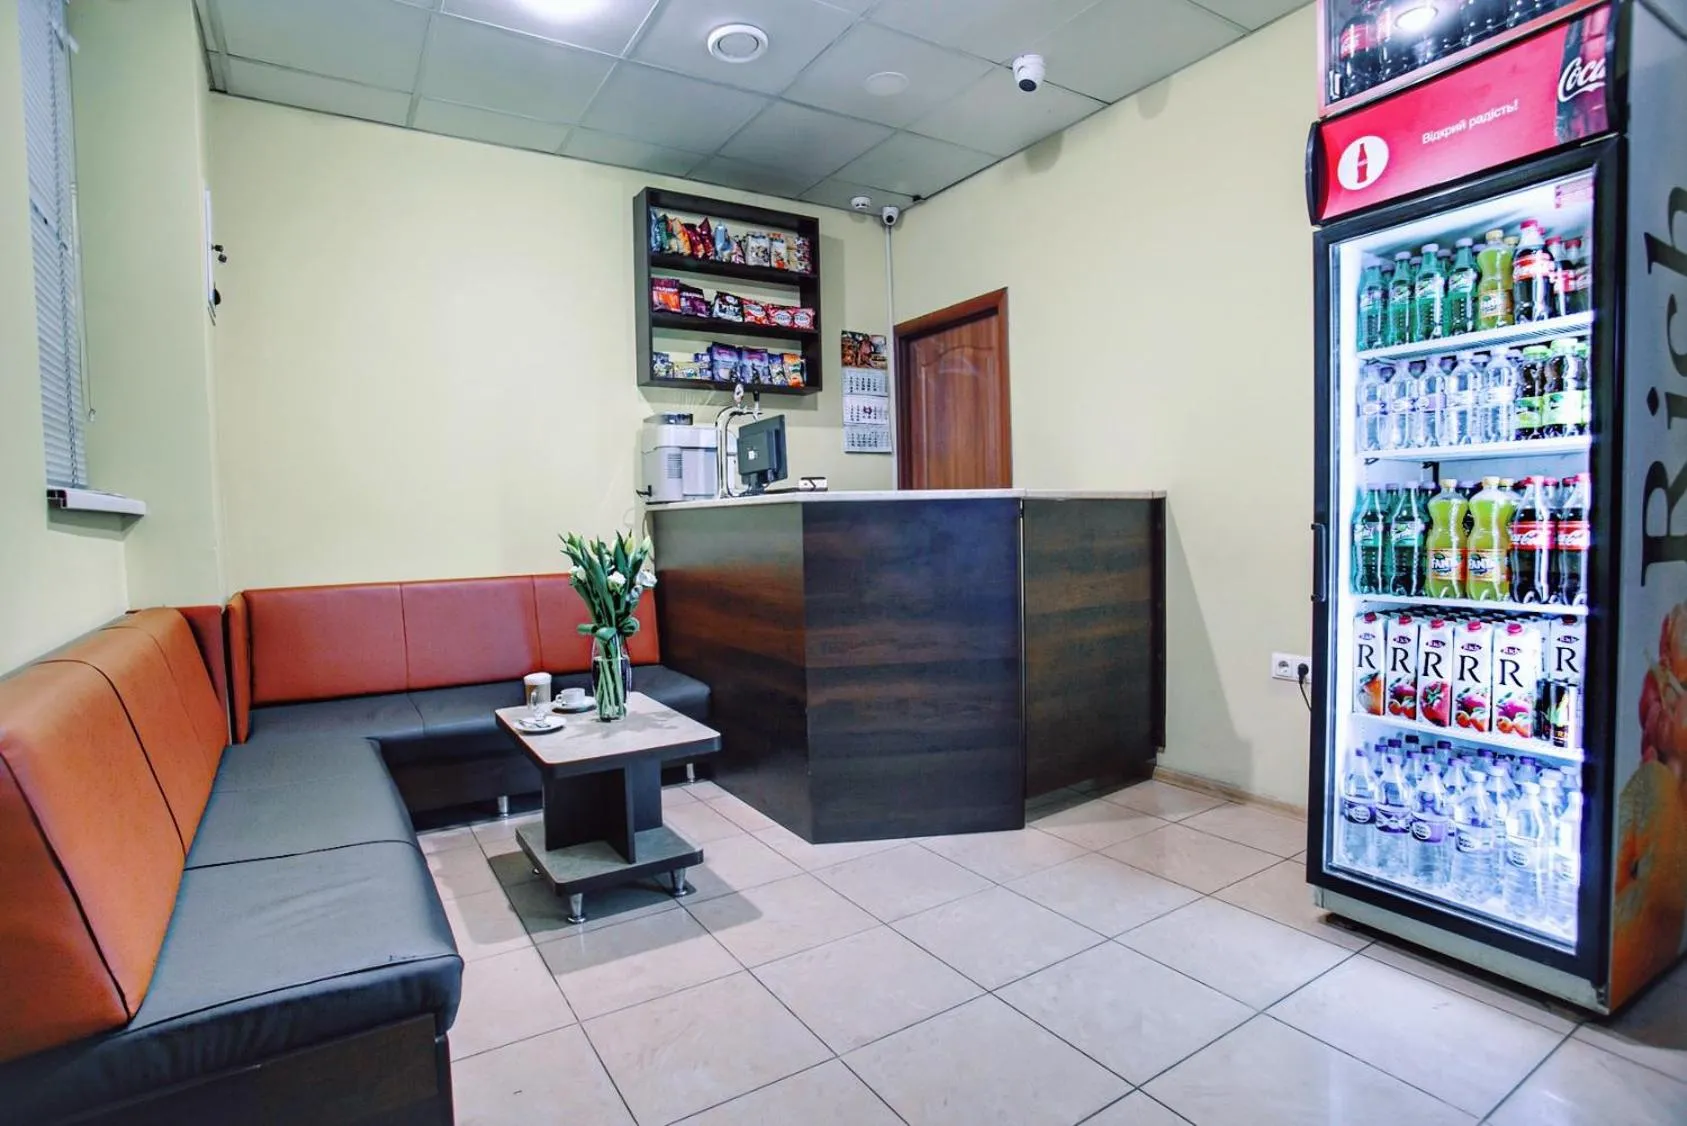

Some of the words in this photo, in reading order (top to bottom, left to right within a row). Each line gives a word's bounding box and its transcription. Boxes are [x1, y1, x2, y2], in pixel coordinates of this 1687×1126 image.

[1422, 118, 1467, 144] Відкрий
[1468, 99, 1519, 130] радість!
[1357, 643, 1376, 670] R
[1391, 646, 1411, 674] R
[1423, 651, 1444, 679] R
[1458, 655, 1481, 683] R
[1555, 646, 1579, 673] R
[1499, 658, 1524, 688] R
